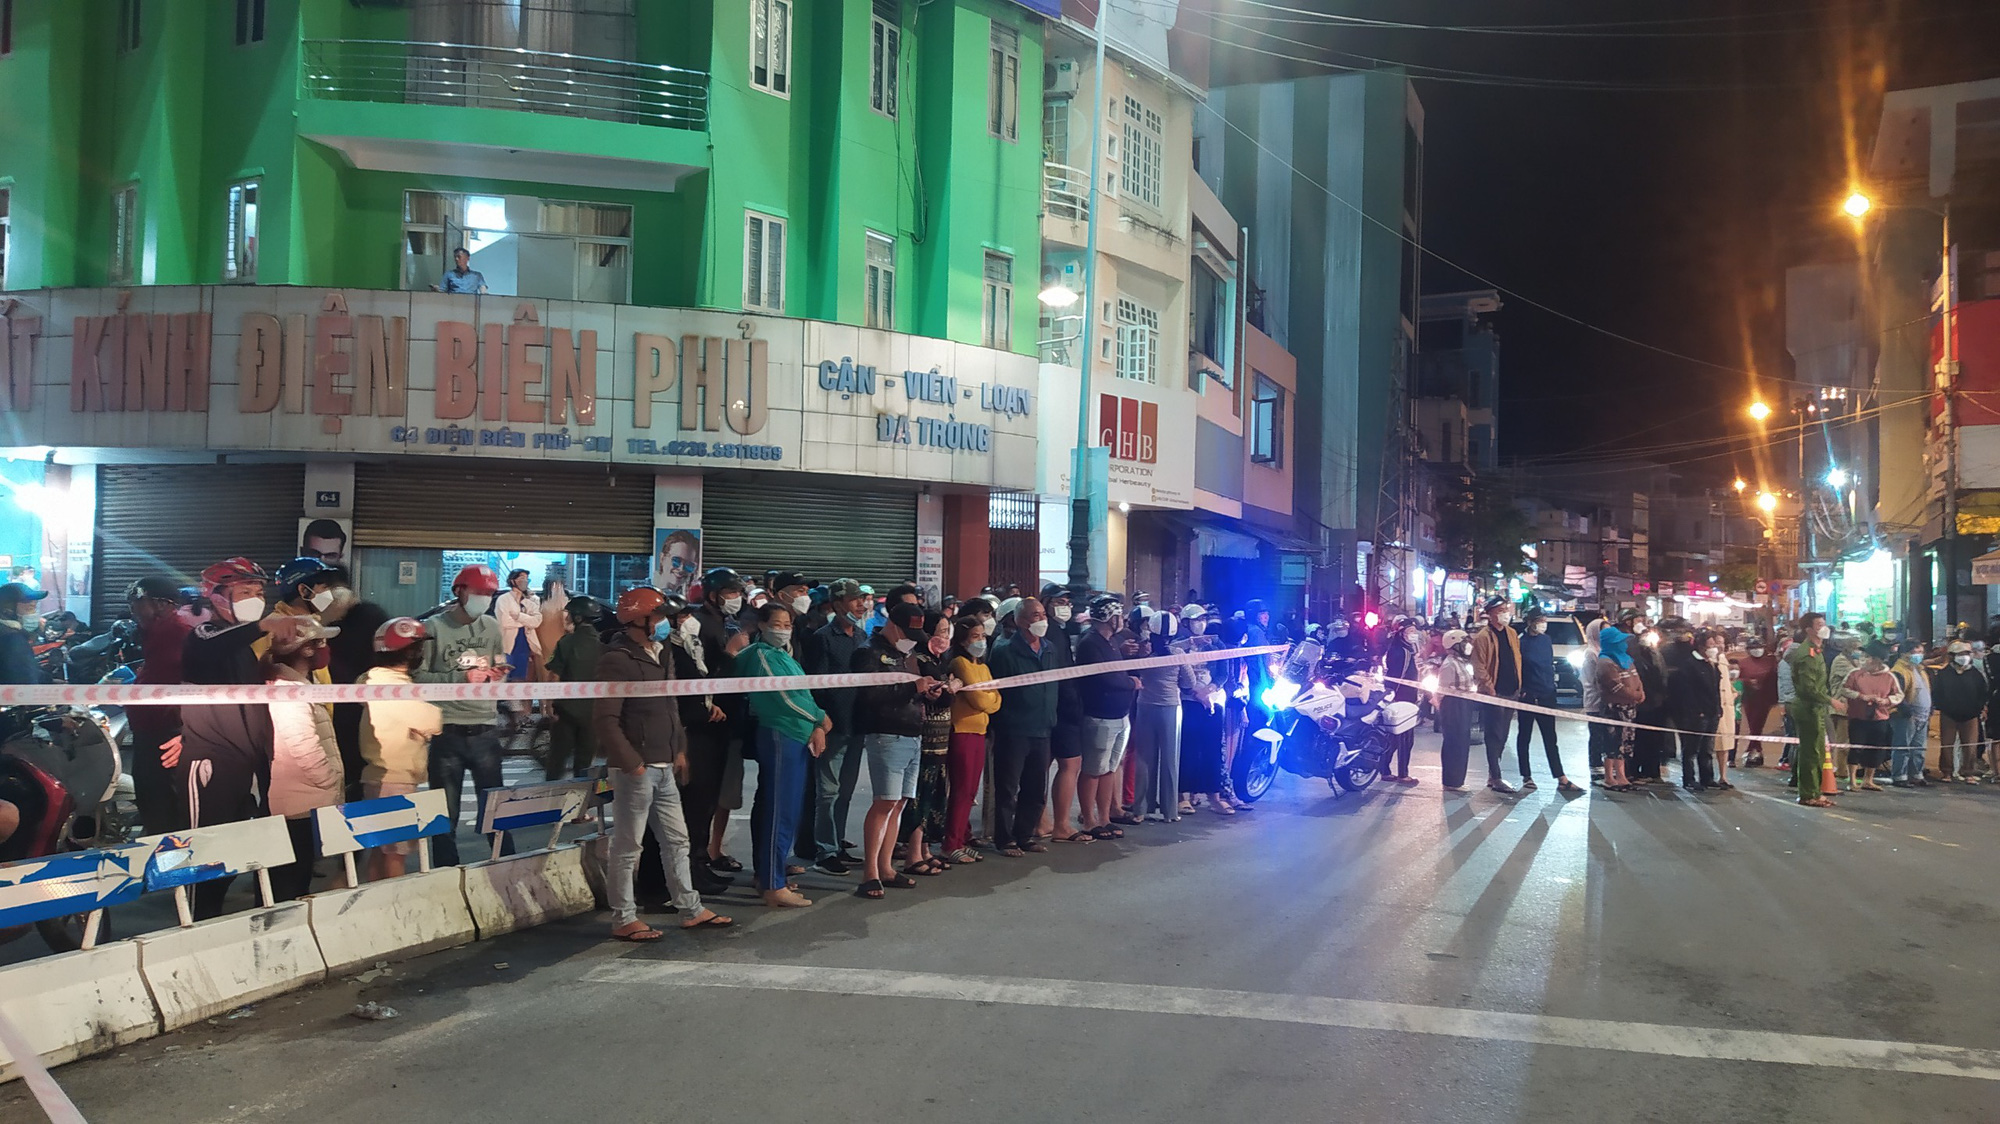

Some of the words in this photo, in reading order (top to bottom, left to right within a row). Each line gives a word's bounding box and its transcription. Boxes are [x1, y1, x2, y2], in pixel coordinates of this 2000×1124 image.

[71, 290, 210, 412] KÍNH
[239, 293, 407, 434] ĐIỆN
[435, 303, 597, 425] BIÊN
[633, 319, 769, 435] PHỦ
[818, 356, 876, 400] CẬN
[981, 381, 1031, 422] LOẠN
[425, 423, 474, 452] ĐIỆN
[479, 426, 526, 448] BIÊN
[877, 413, 912, 445] ĐA
[917, 413, 991, 452] TRÒNG
[1101, 428, 1153, 460] GHB
[1109, 464, 1153, 477] RPORATION
[320, 493, 337, 502] 64
[670, 503, 688, 513] 174
[1313, 702, 1333, 712] POLICE
